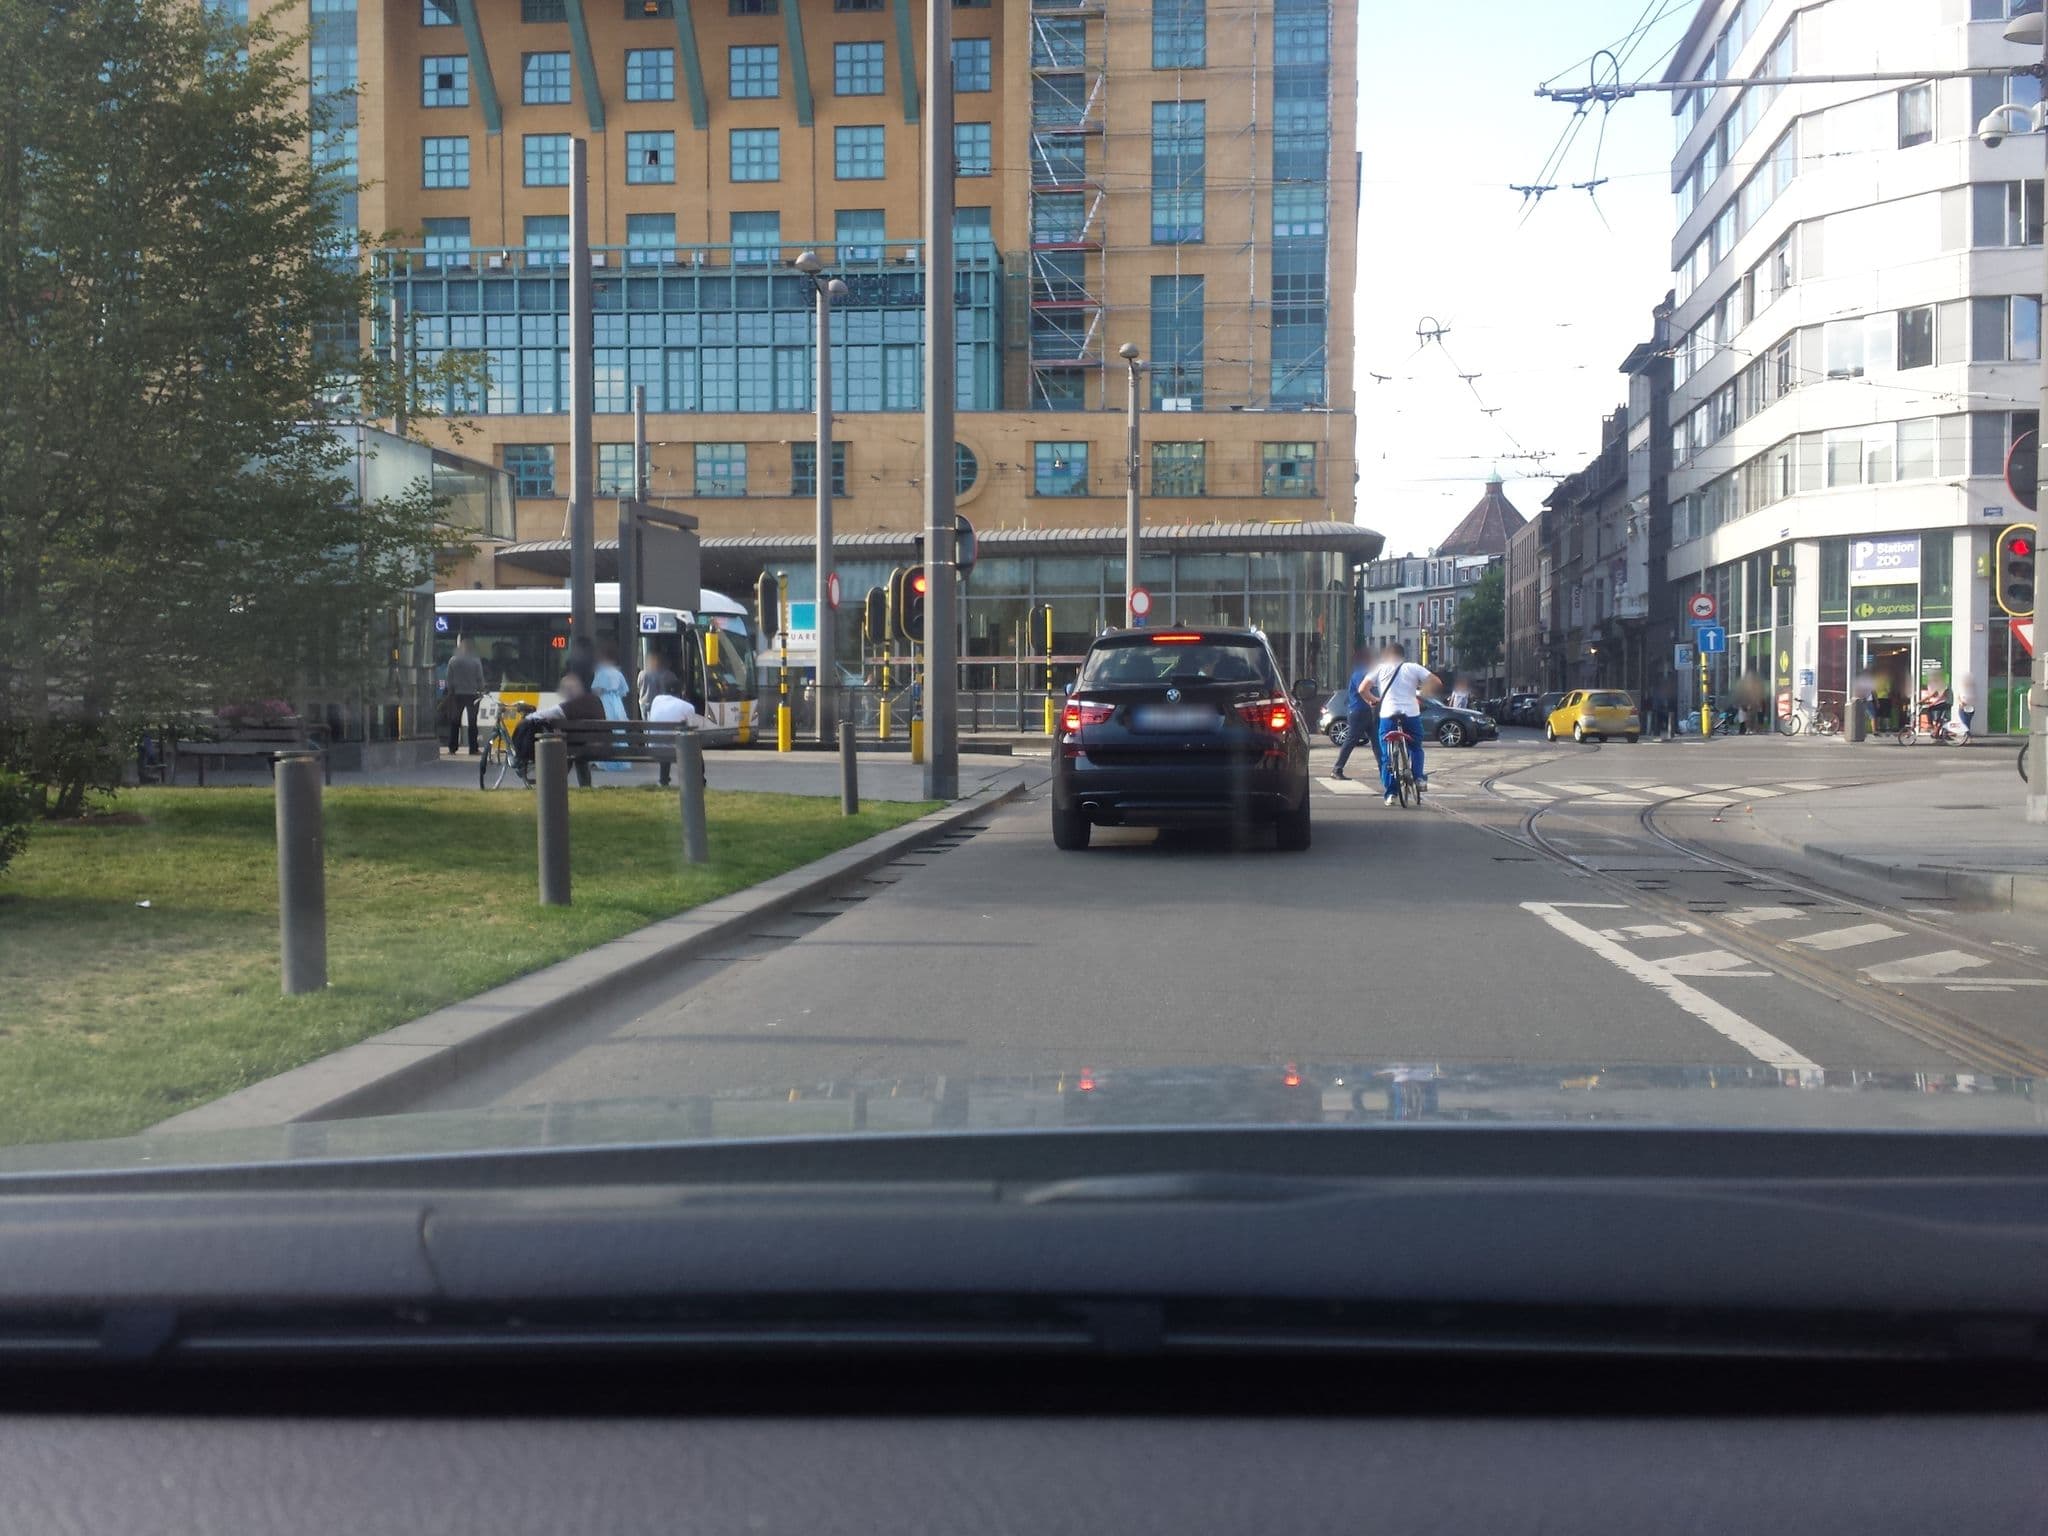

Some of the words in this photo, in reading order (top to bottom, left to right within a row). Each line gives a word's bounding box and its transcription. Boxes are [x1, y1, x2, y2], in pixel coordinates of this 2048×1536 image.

[1877, 543, 1914, 553] Station
[1856, 542, 1873, 568] P
[1877, 604, 1916, 614] express
